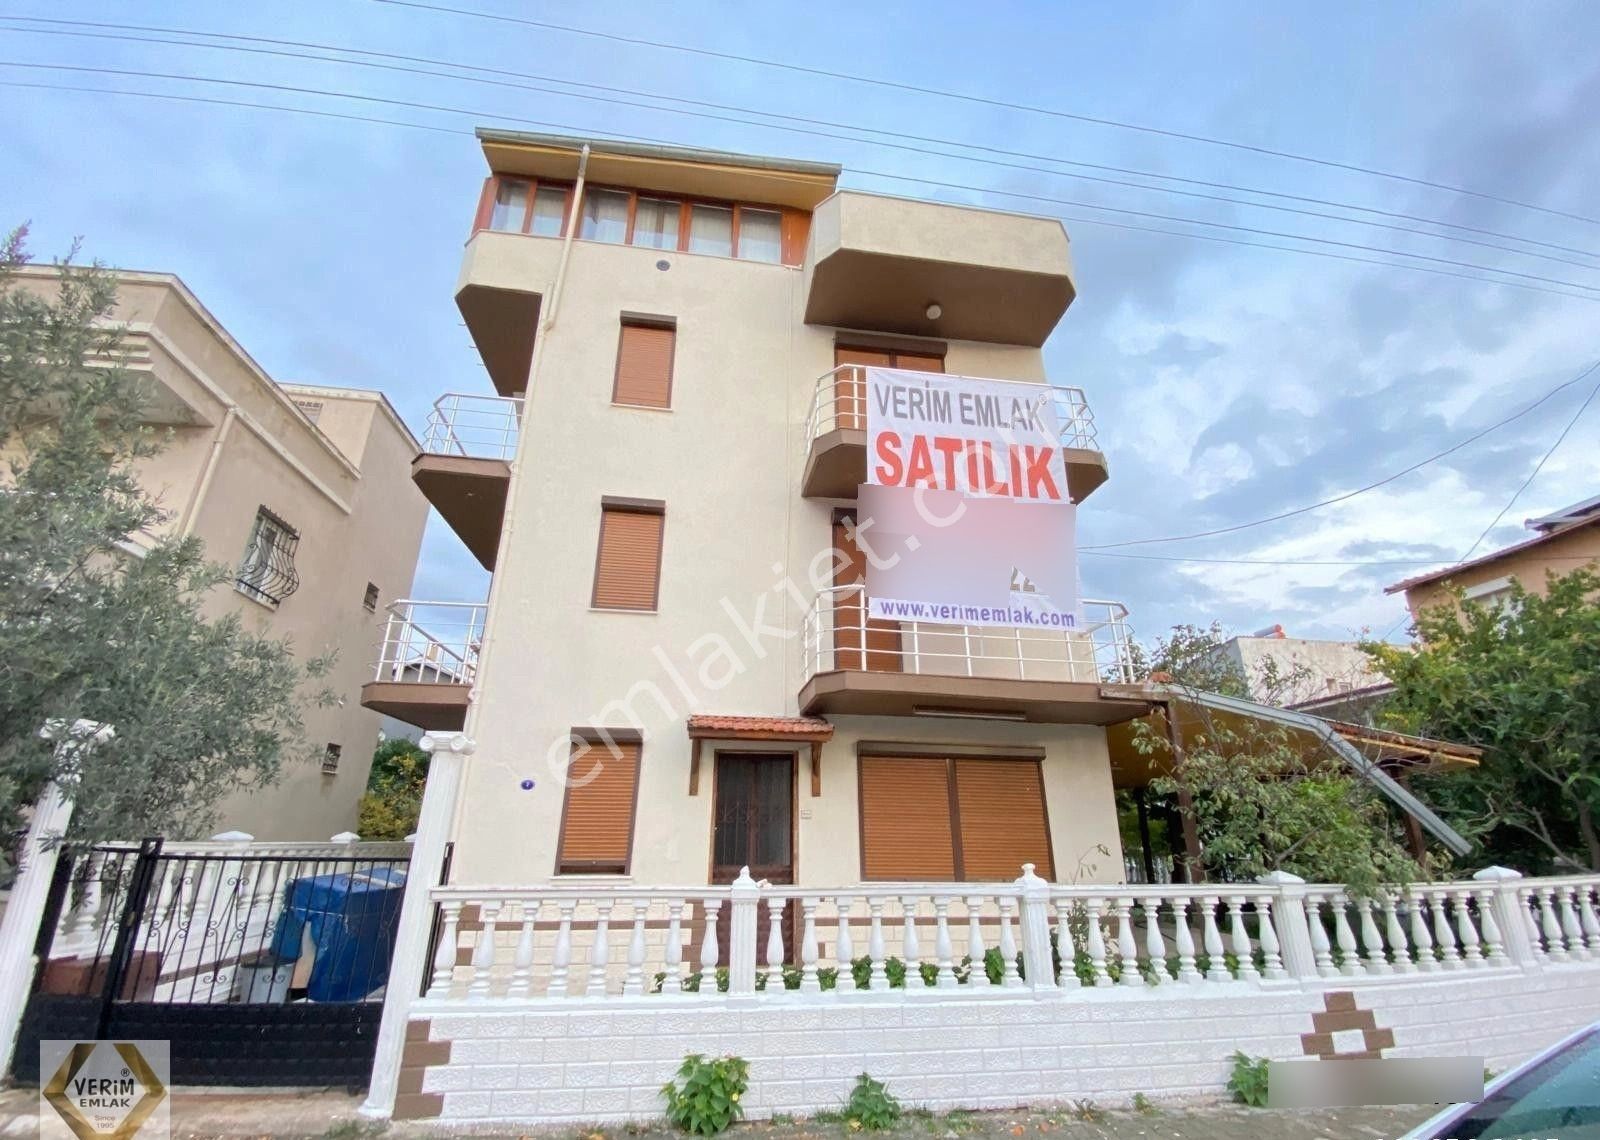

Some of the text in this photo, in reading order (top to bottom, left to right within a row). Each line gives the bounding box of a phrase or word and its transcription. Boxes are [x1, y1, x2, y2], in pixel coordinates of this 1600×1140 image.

[959, 392, 1045, 433] EMLAK
[875, 430, 1061, 500] SATILIK
[880, 601, 1076, 627] www.verimemlak.com
